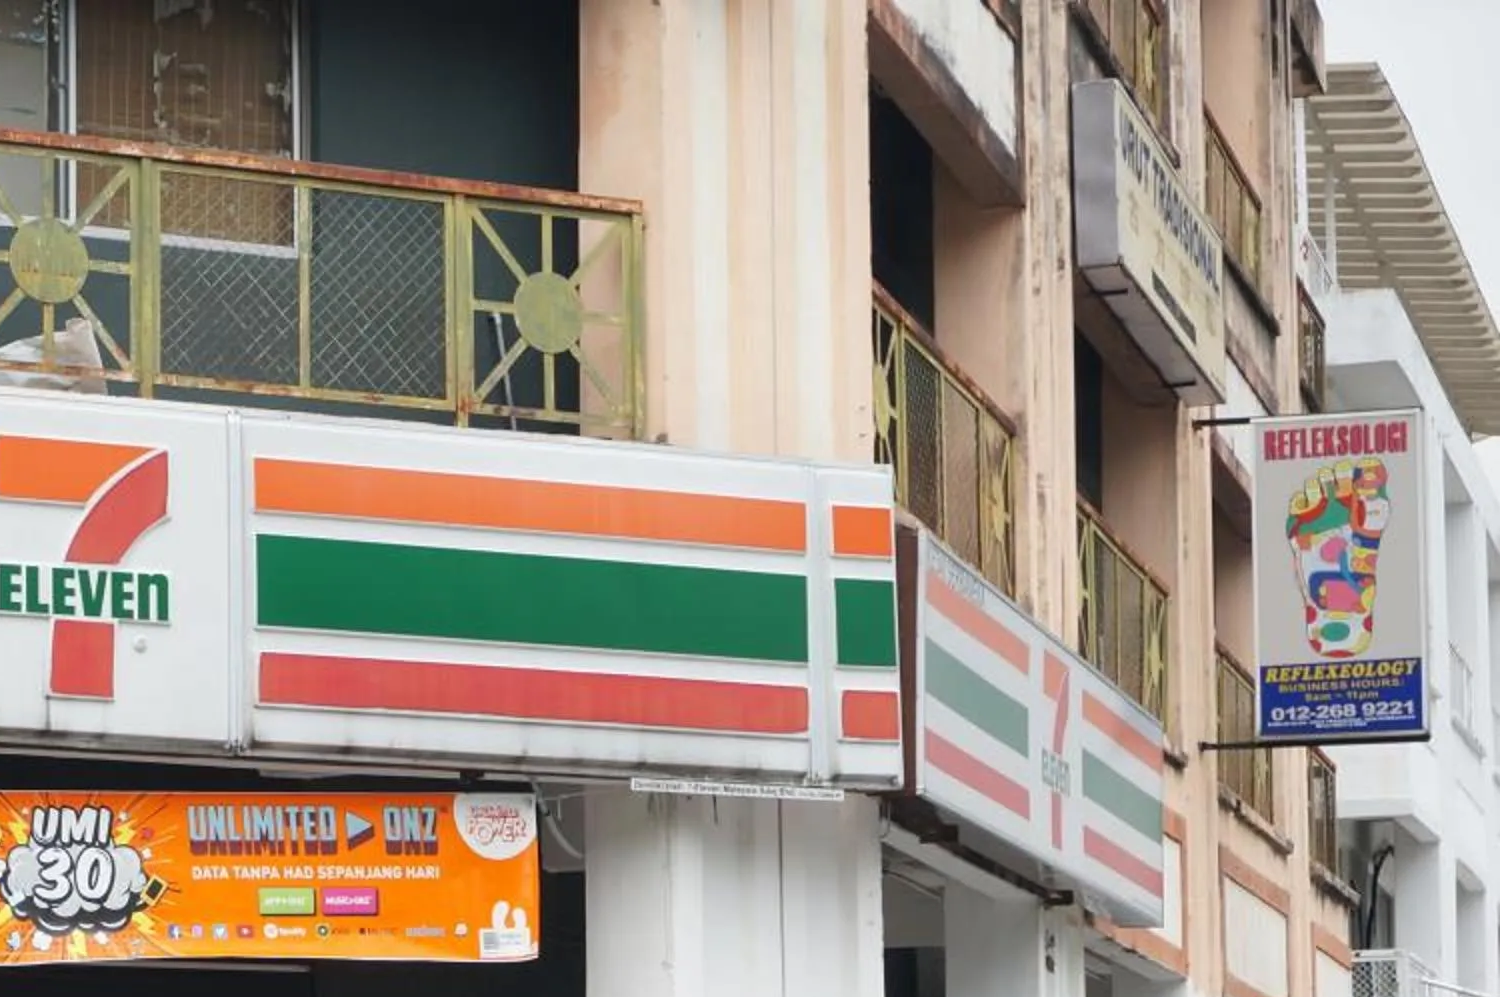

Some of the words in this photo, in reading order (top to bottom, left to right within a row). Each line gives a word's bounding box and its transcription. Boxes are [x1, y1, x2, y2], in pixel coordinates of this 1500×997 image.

[1264, 421, 1408, 461] REFLEKSOLOGI
[1271, 703, 1357, 721] 012-268
[1362, 700, 1415, 716] 9221
[32, 805, 112, 846] UMI
[187, 805, 337, 850] UNLIMITED
[468, 816, 528, 846] POWER
[33, 847, 116, 901] 30
[192, 865, 229, 880] DATA
[232, 865, 280, 880] TANPA
[283, 866, 314, 880] HAD
[317, 866, 403, 880] SEPANJANG
[405, 866, 440, 880] HARI
